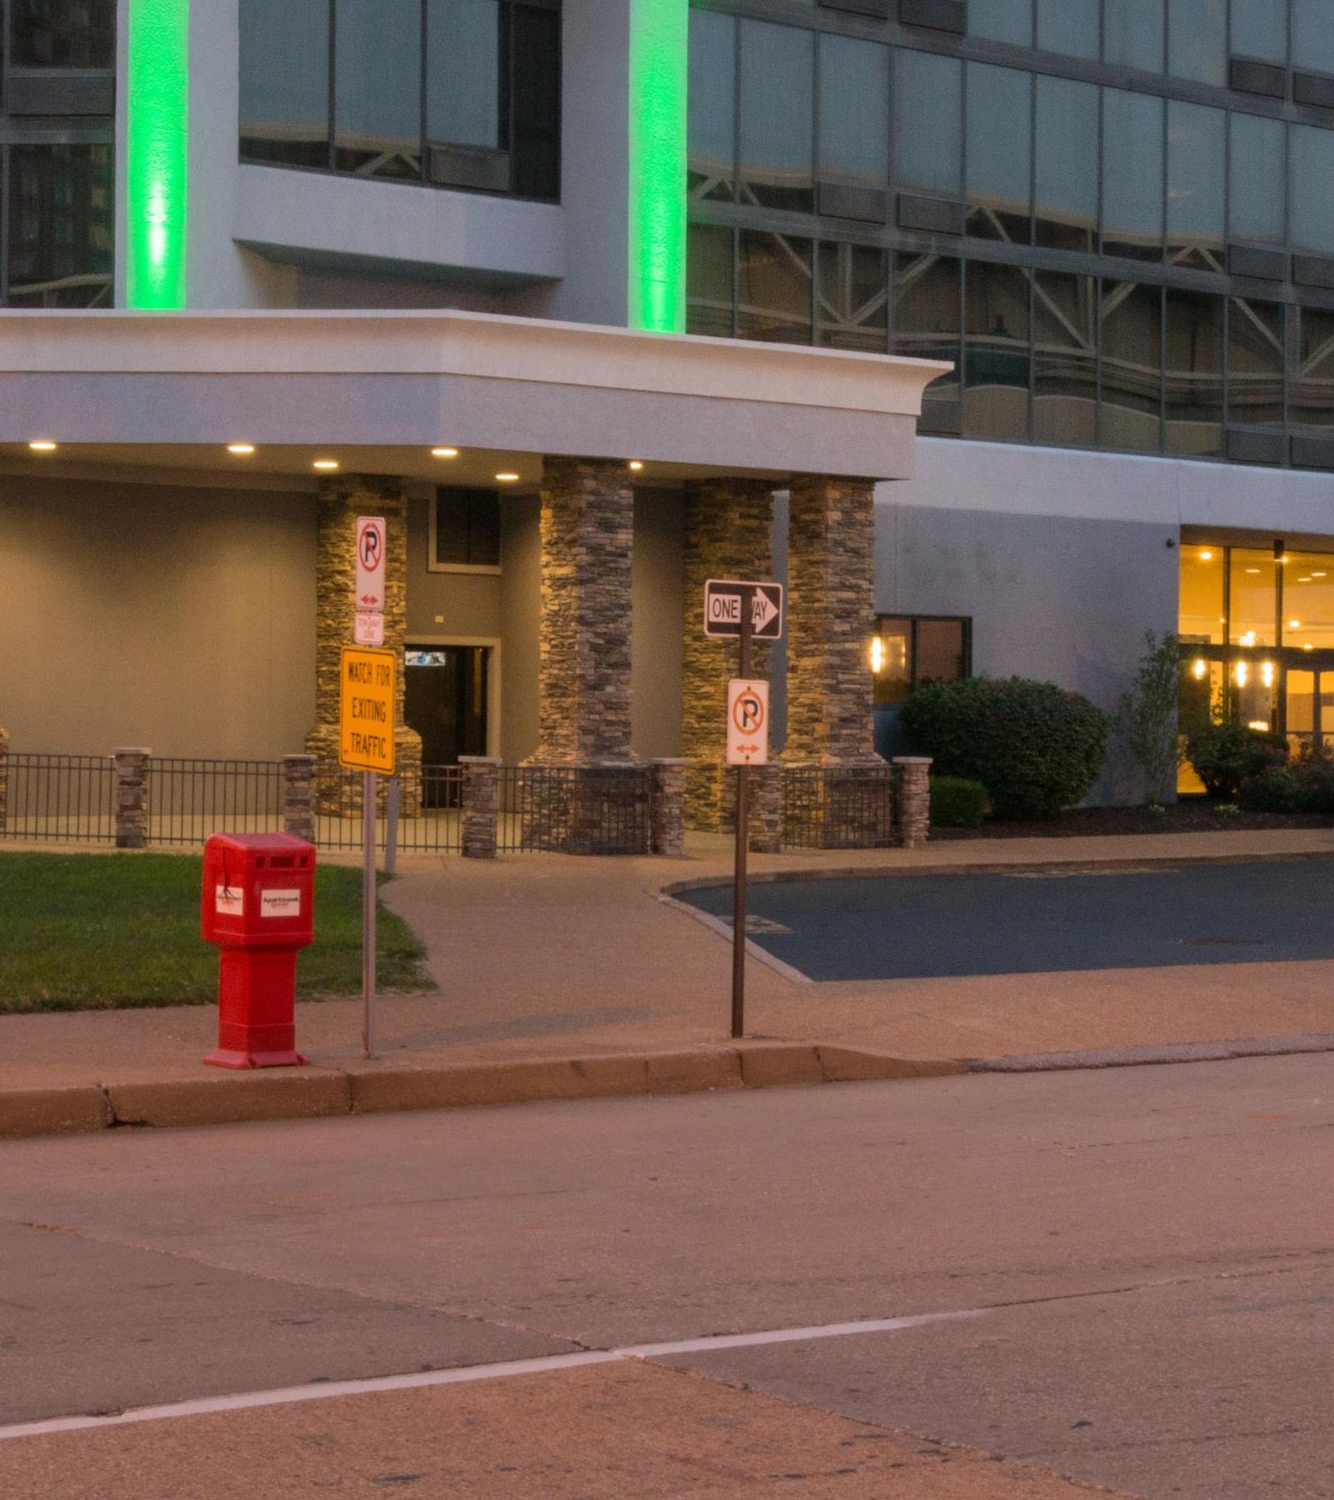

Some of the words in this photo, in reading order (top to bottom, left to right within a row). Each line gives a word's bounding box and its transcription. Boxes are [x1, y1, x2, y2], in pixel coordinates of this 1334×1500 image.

[712, 598, 739, 619] ONE
[752, 600, 768, 620] AY
[348, 661, 373, 684] WATCH
[376, 664, 391, 687] FOR
[352, 697, 386, 723] EXITING
[743, 699, 759, 728] P
[350, 731, 387, 759] TRAFFIC
